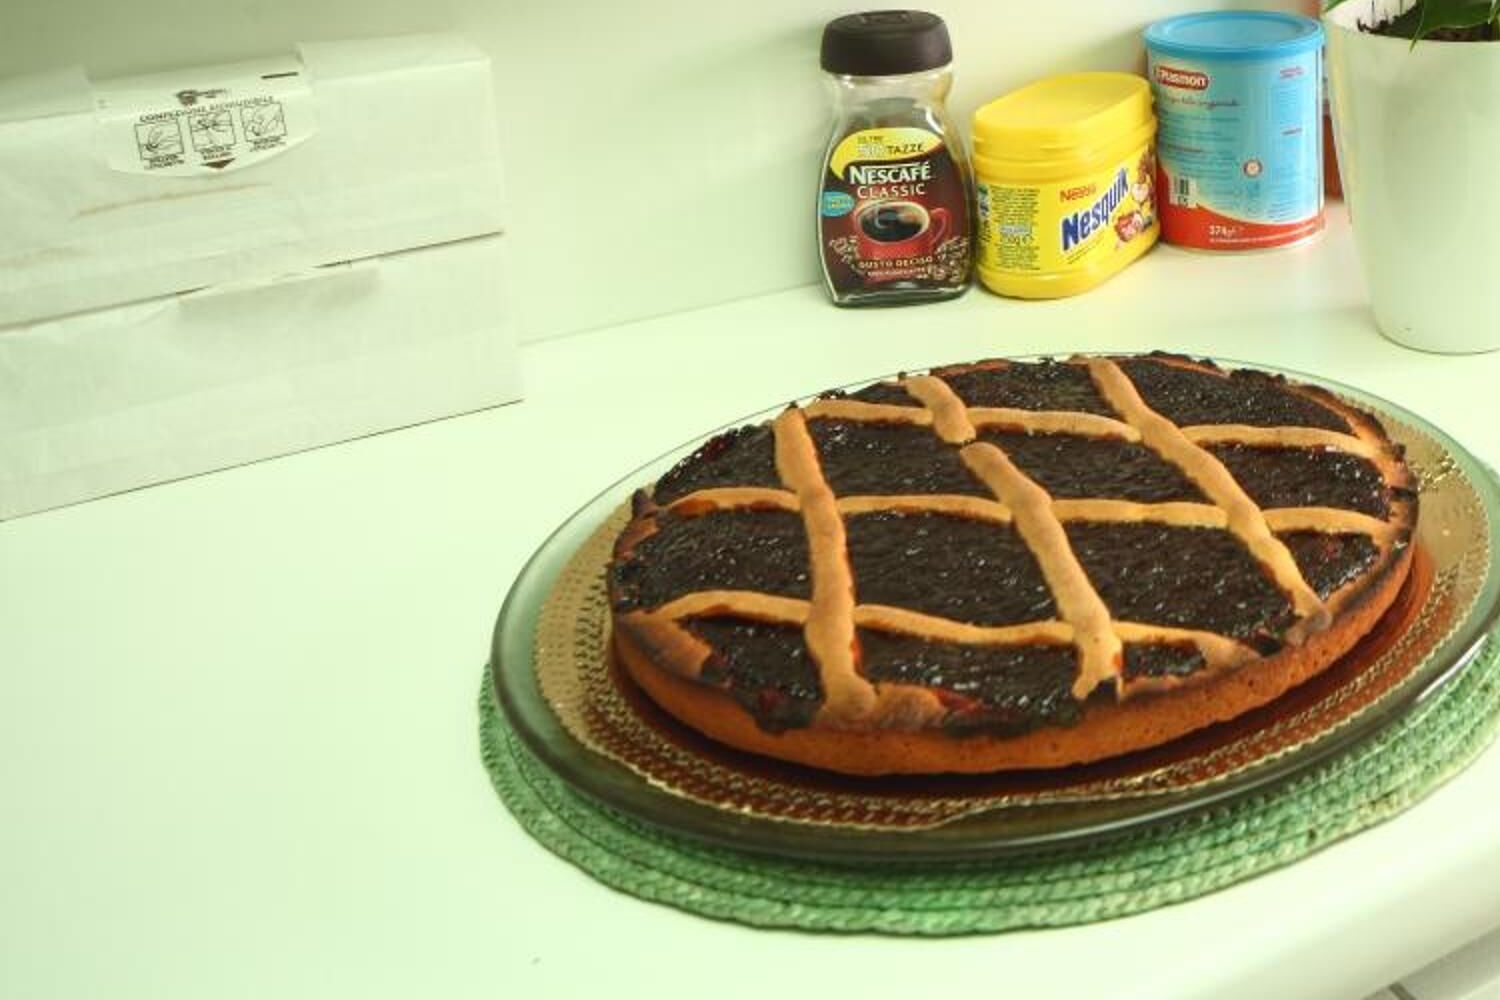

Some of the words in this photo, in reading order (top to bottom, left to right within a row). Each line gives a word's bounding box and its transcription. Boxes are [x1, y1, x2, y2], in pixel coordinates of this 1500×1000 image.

[886, 143, 925, 155] TAZZE
[848, 160, 931, 186] NESCAFÉ
[857, 183, 926, 200] CLASSIC
[859, 260, 893, 270] GUSTO
